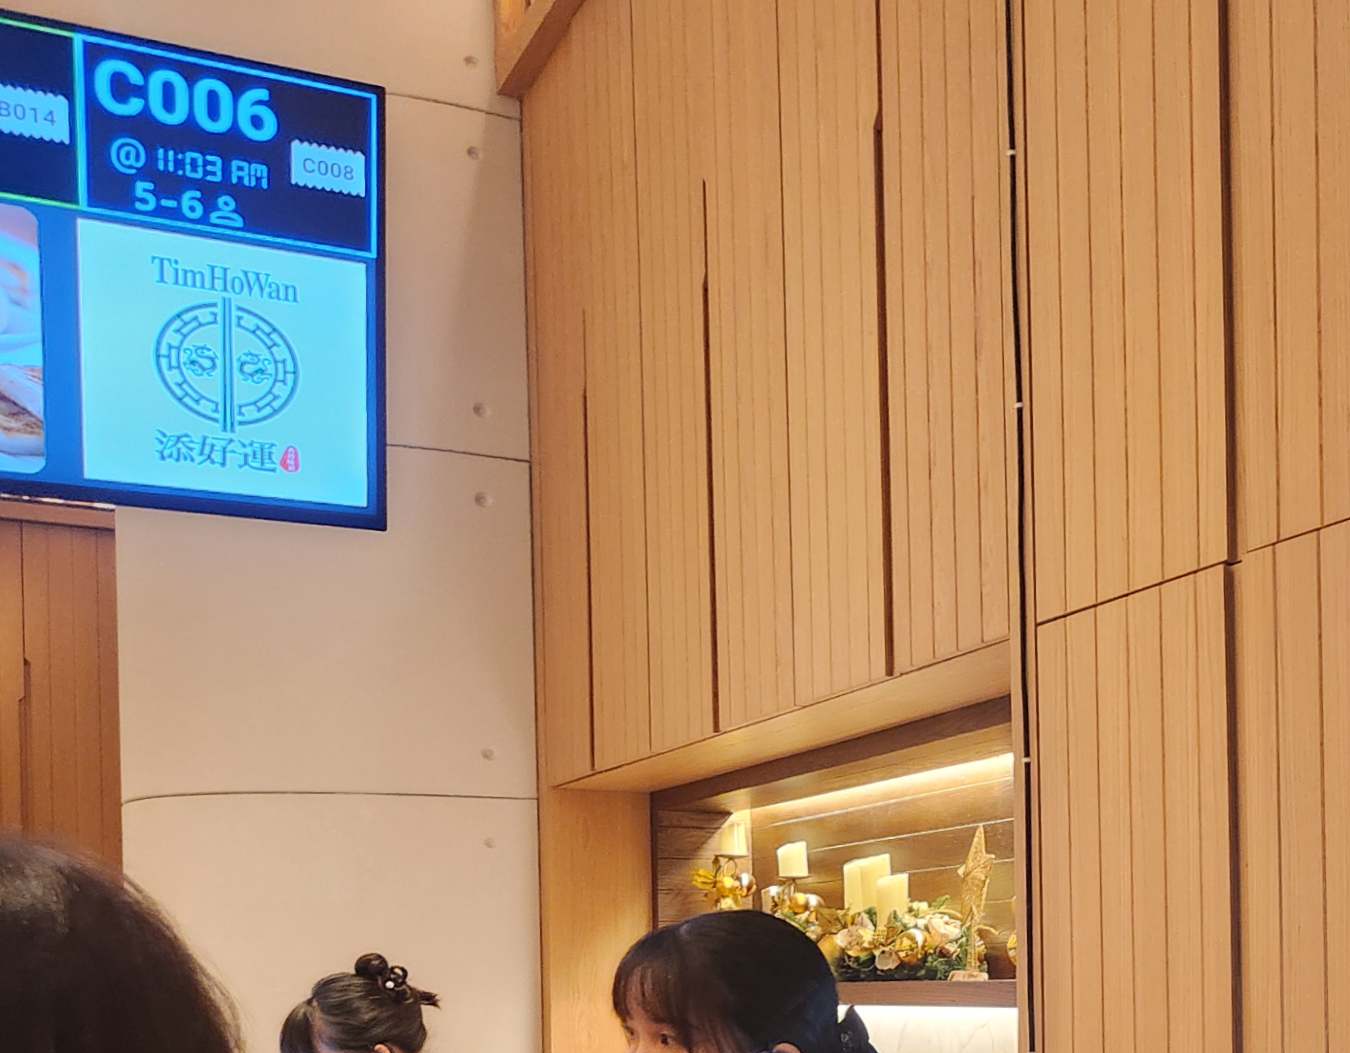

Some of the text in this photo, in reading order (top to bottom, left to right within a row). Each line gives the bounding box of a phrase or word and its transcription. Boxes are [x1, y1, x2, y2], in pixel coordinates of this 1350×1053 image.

[0, 100, 57, 127] B014
[94, 59, 279, 142] C006
[110, 137, 270, 190] @ 11:03 AM
[302, 157, 356, 182] C008
[134, 181, 205, 220] 5-6
[151, 255, 299, 303] TimHoWan
[155, 429, 278, 473] 添好運
